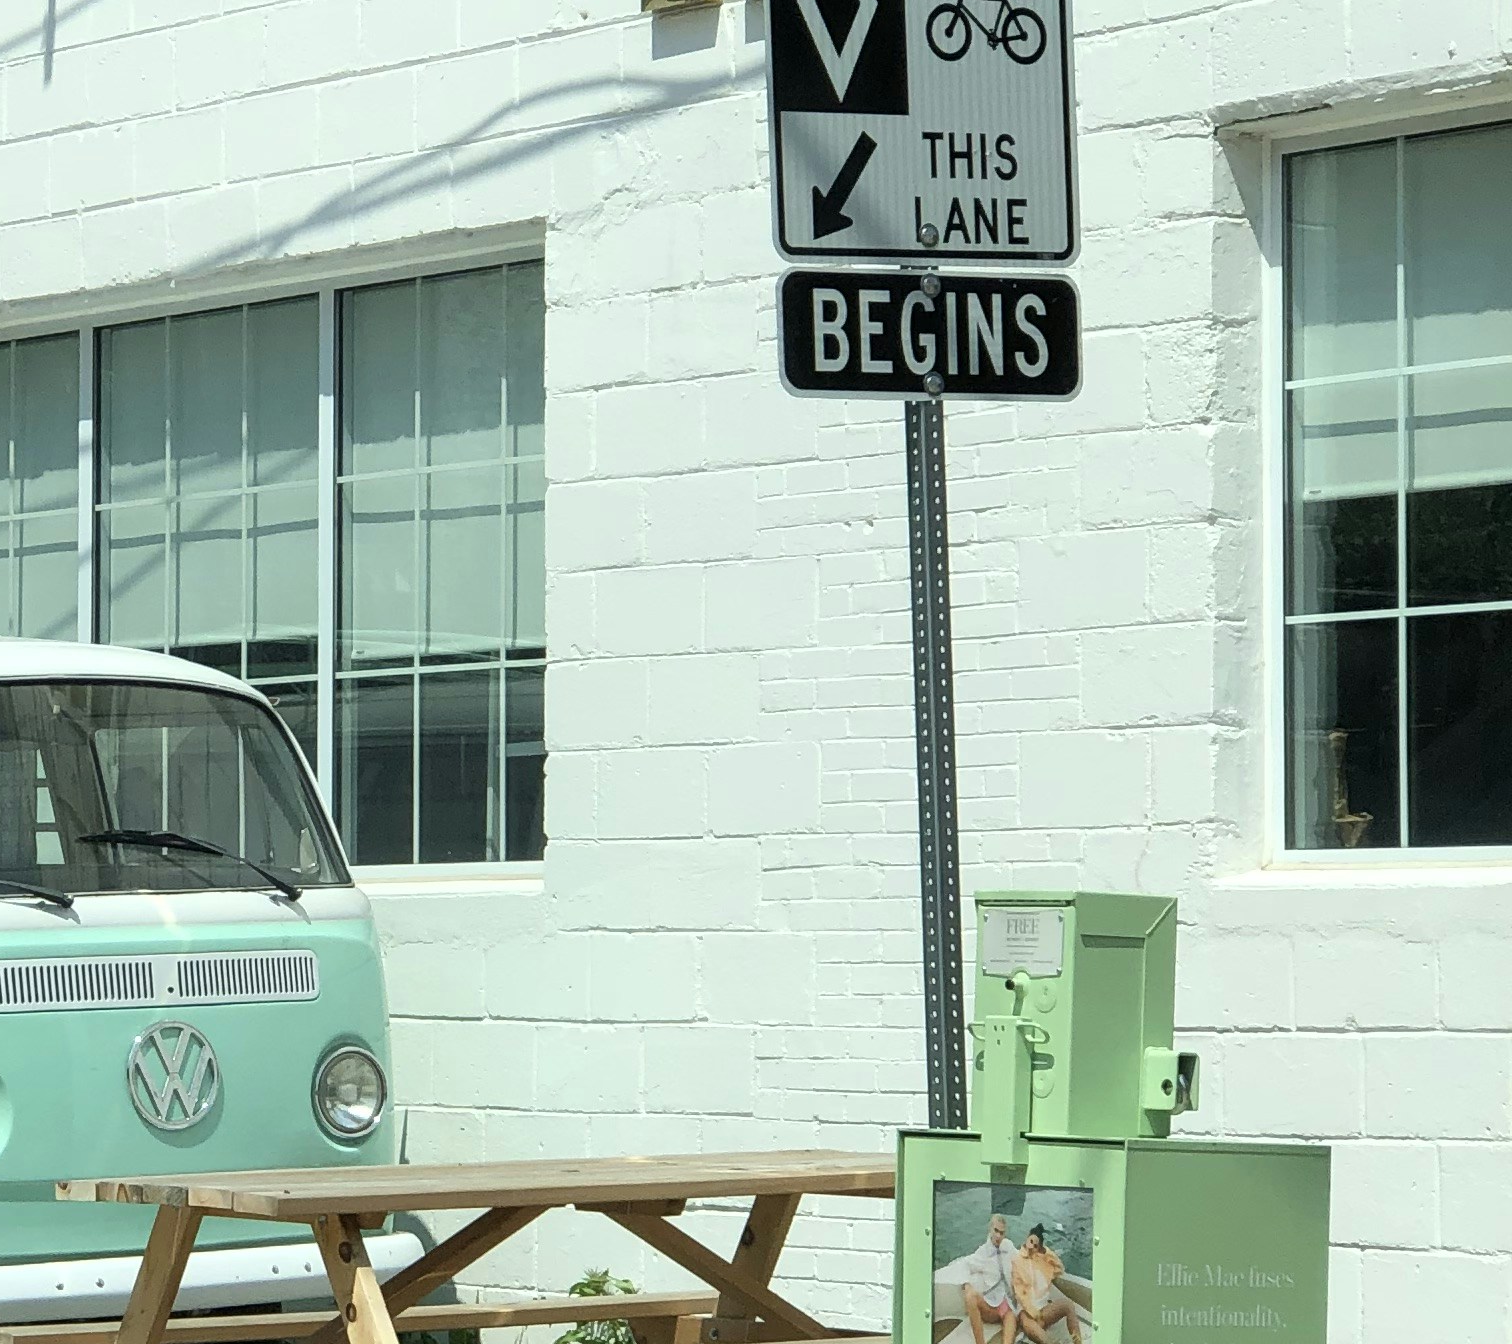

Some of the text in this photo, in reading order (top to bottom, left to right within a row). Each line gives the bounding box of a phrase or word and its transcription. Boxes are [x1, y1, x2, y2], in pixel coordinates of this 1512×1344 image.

[922, 131, 1019, 182] THIS
[915, 196, 1030, 245] LANE
[812, 287, 1050, 379] BEGINS
[1007, 918, 1040, 935] FREE
[129, 1022, 218, 1130] VW
[1156, 1263, 1295, 1289] Ellie Mae fuses
